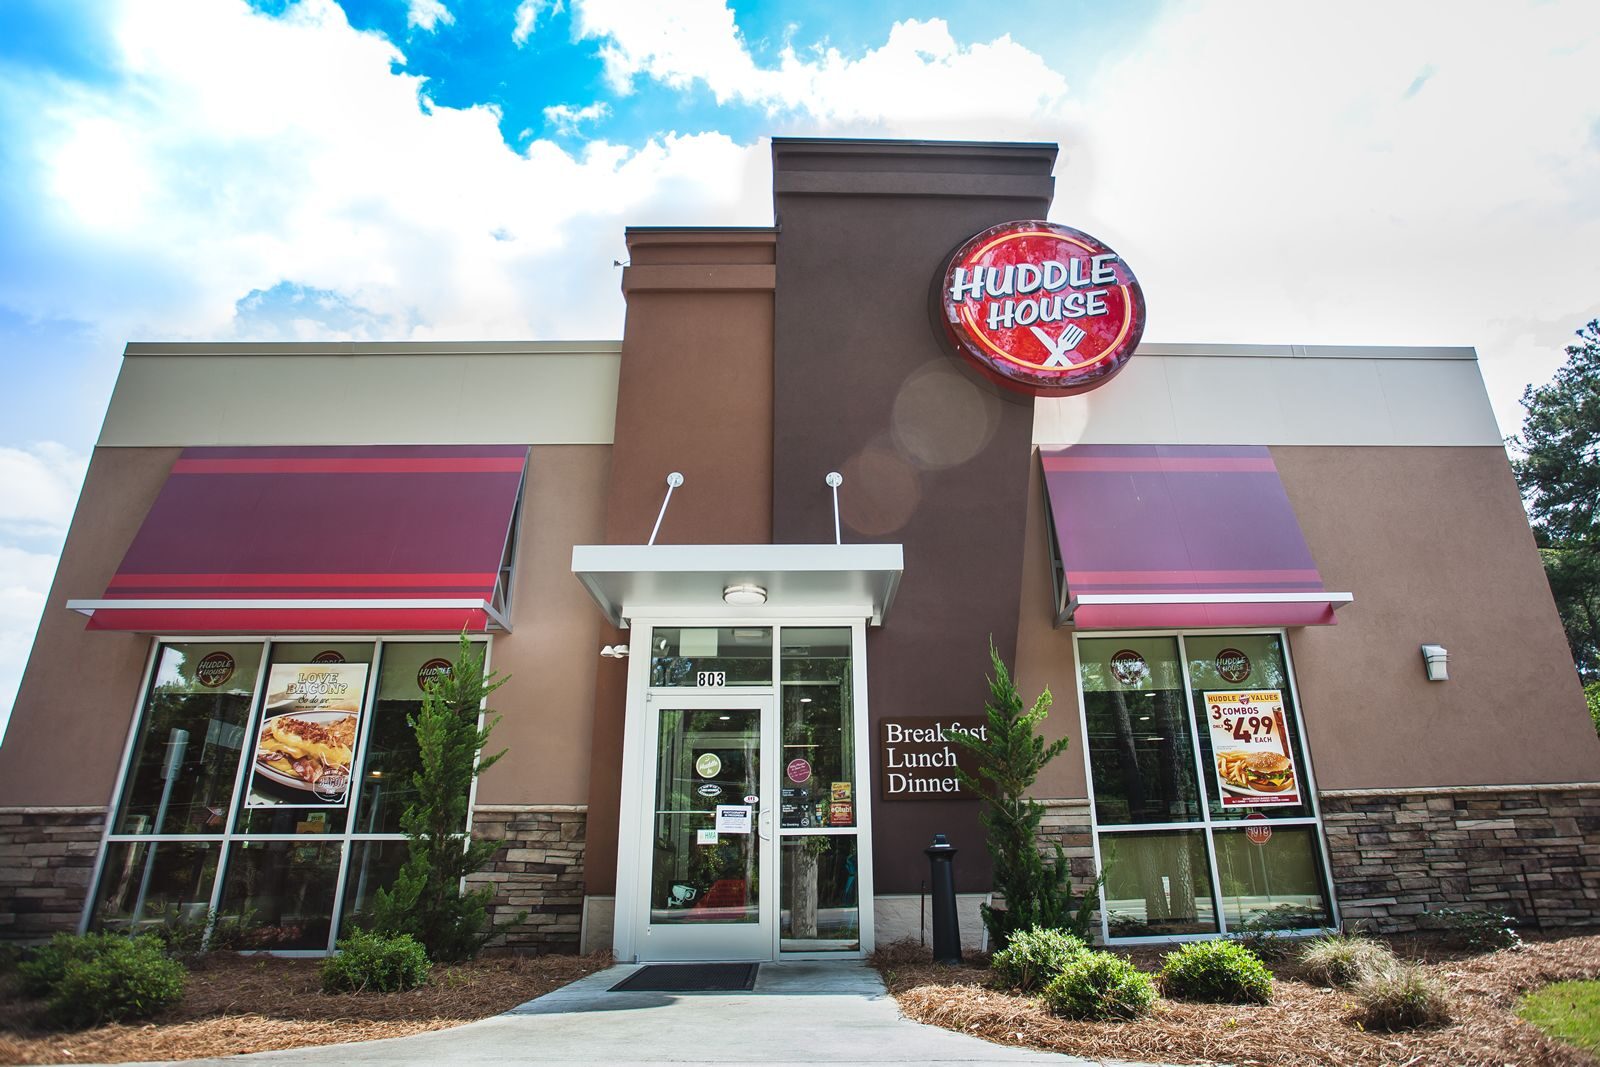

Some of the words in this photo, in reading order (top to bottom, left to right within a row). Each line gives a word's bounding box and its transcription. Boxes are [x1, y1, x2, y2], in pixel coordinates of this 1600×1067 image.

[949, 253, 1120, 302] HUDDLE
[986, 290, 1108, 331] HOUSE
[199, 660, 232, 669] HUDDLE
[203, 668, 227, 676] HOUSE
[298, 673, 339, 684] LOVE
[698, 672, 724, 687] 803
[286, 683, 348, 694] BACON?
[1211, 704, 1222, 720] 3
[1222, 706, 1259, 715] COMBOS
[886, 746, 958, 768] Lunch
